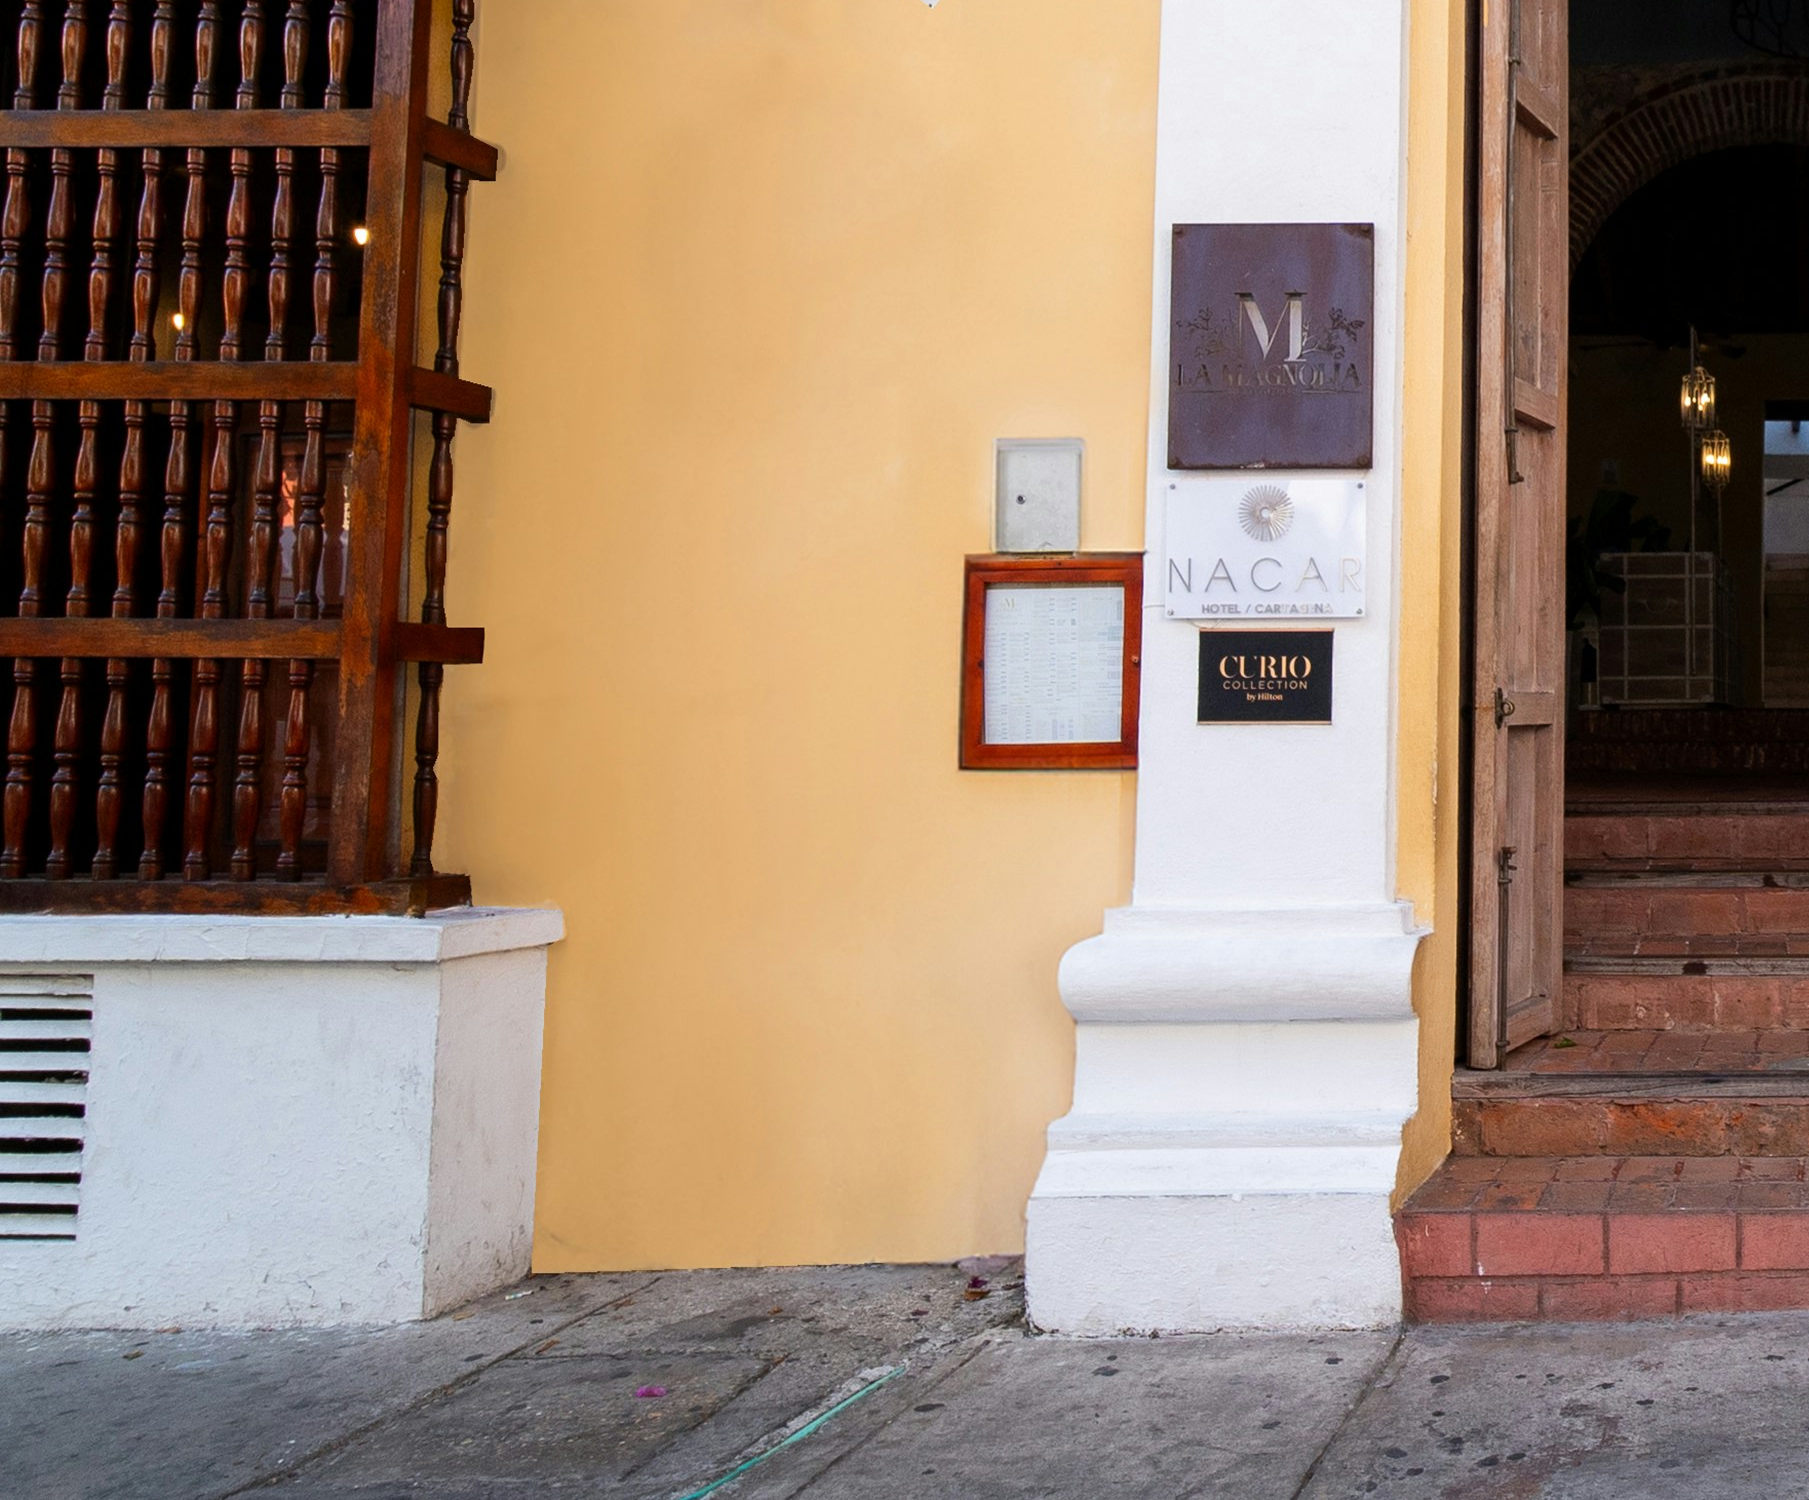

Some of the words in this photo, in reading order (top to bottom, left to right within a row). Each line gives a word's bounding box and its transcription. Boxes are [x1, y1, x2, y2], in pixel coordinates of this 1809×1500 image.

[1234, 291, 1308, 362] M
[1175, 363, 1213, 387] LA
[1221, 362, 1361, 387] MAGNOLIA
[1168, 556, 1362, 594] NACAR
[1202, 603, 1241, 614] HOTEL
[1219, 655, 1312, 679] CURIO
[1222, 680, 1308, 691] COLLECTION
[1246, 693, 1257, 703] by
[1257, 693, 1284, 702] Hilton
